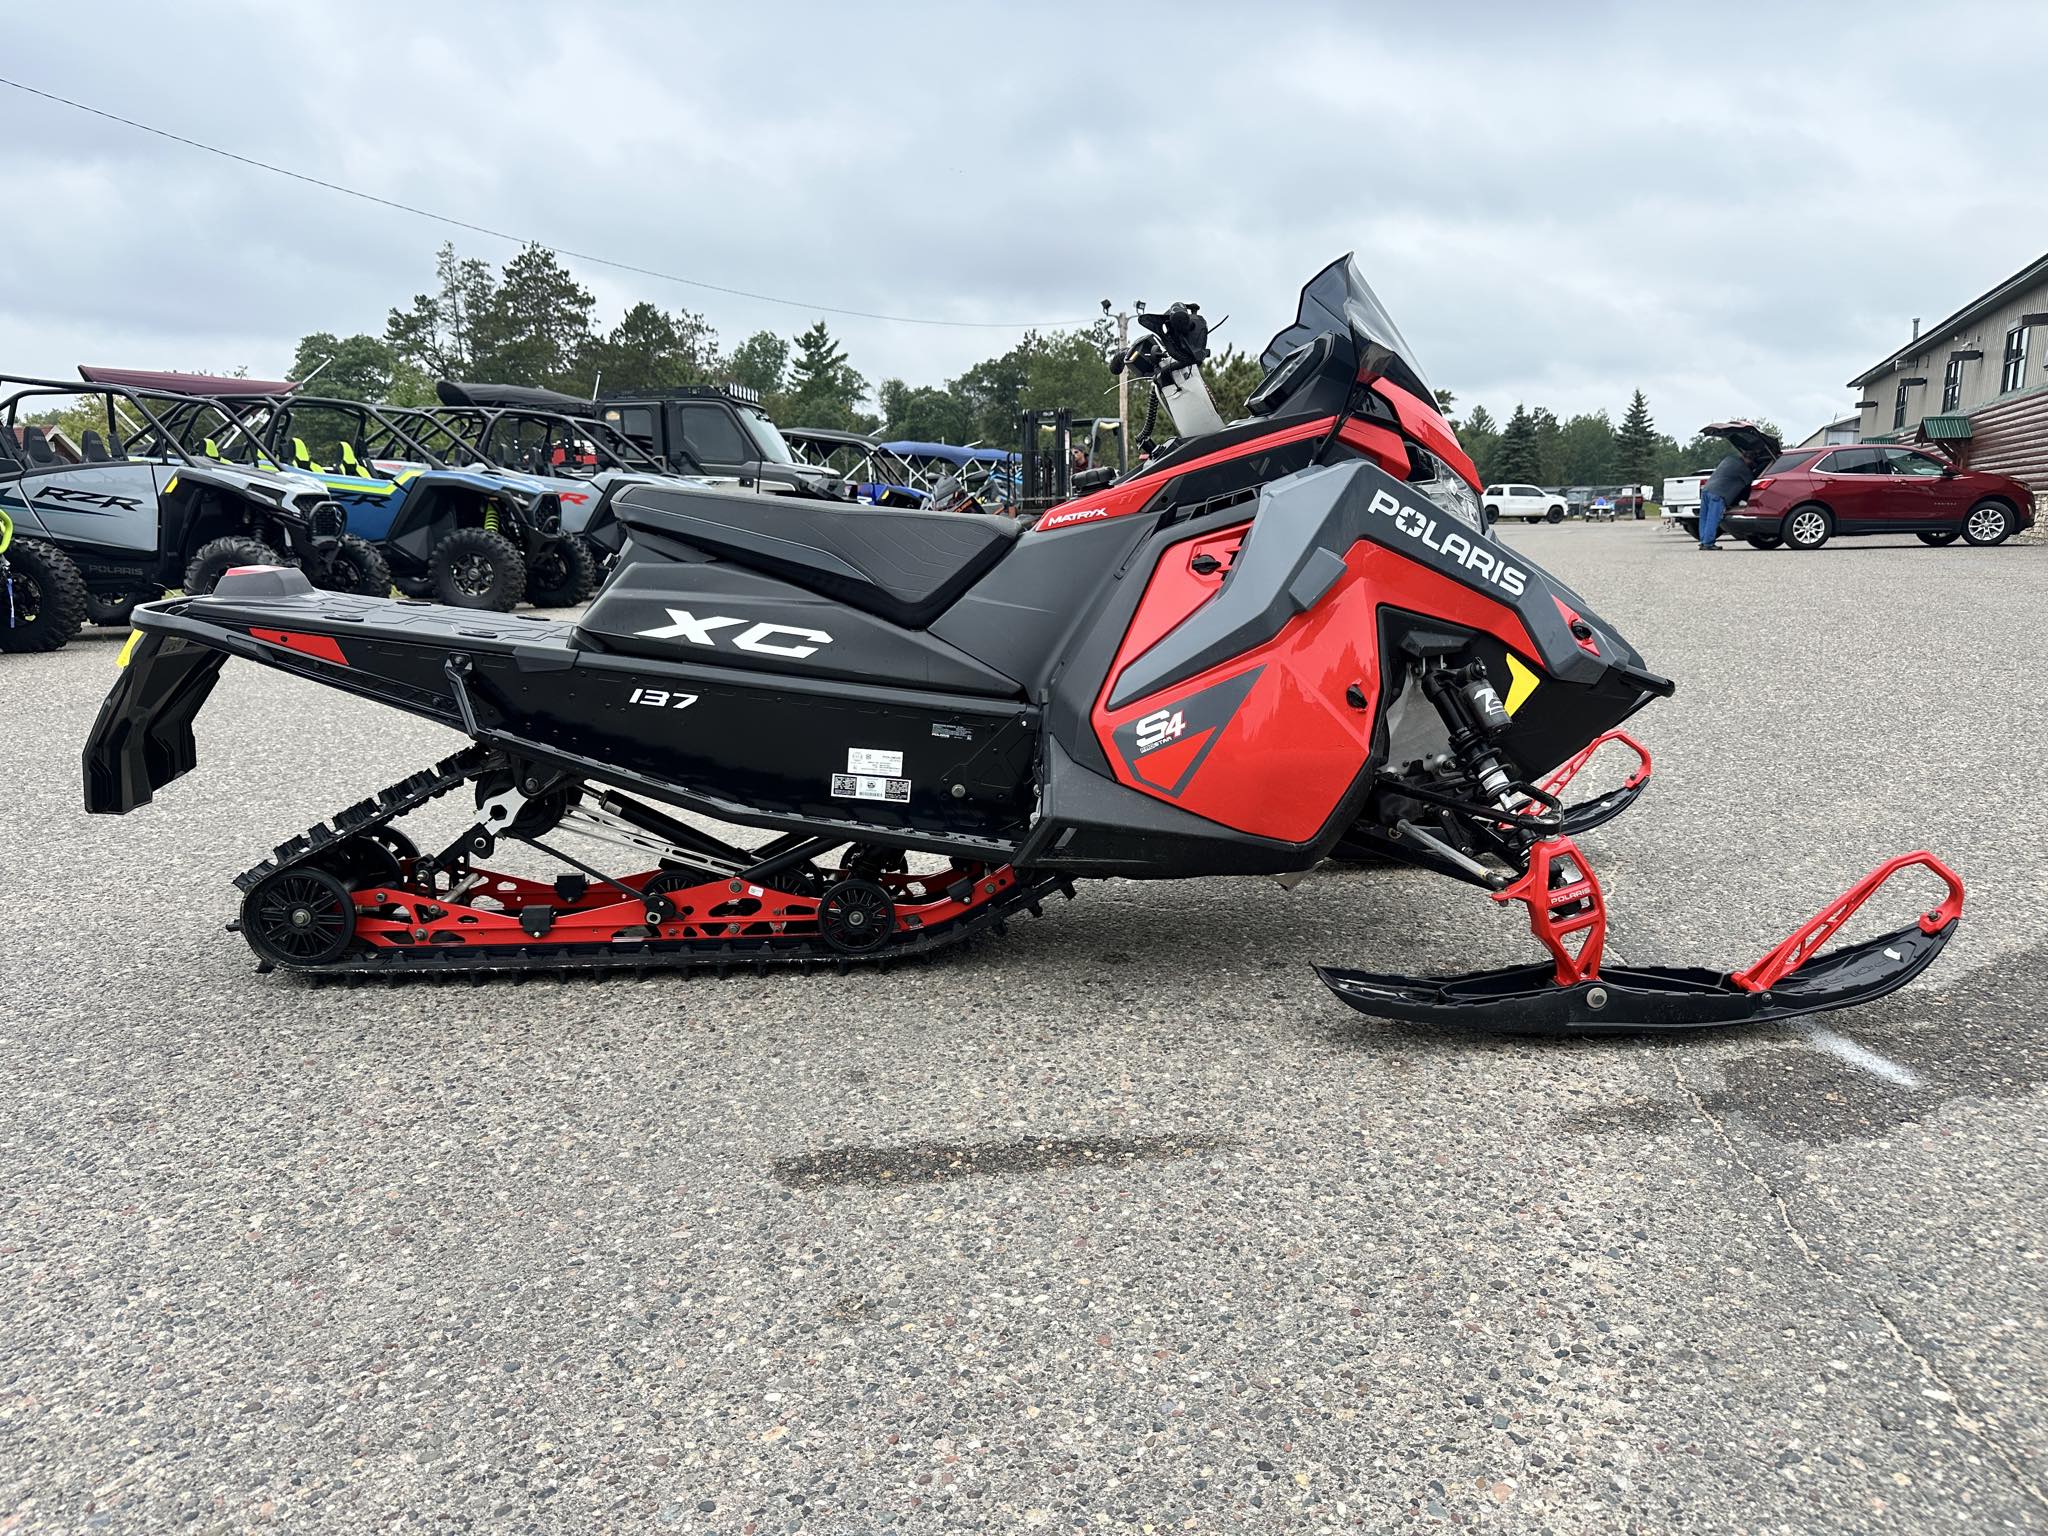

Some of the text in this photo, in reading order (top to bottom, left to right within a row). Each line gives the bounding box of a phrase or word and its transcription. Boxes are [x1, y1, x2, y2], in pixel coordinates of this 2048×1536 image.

[33, 486, 144, 512] RZR
[1048, 507, 1108, 526] MATRYX
[1367, 488, 1528, 597] POLARIS
[88, 563, 144, 576] POLARIS
[634, 608, 833, 658] XC
[629, 688, 698, 709] 137
[1136, 709, 1186, 747] S4
[1550, 886, 1591, 904] POLARIS
